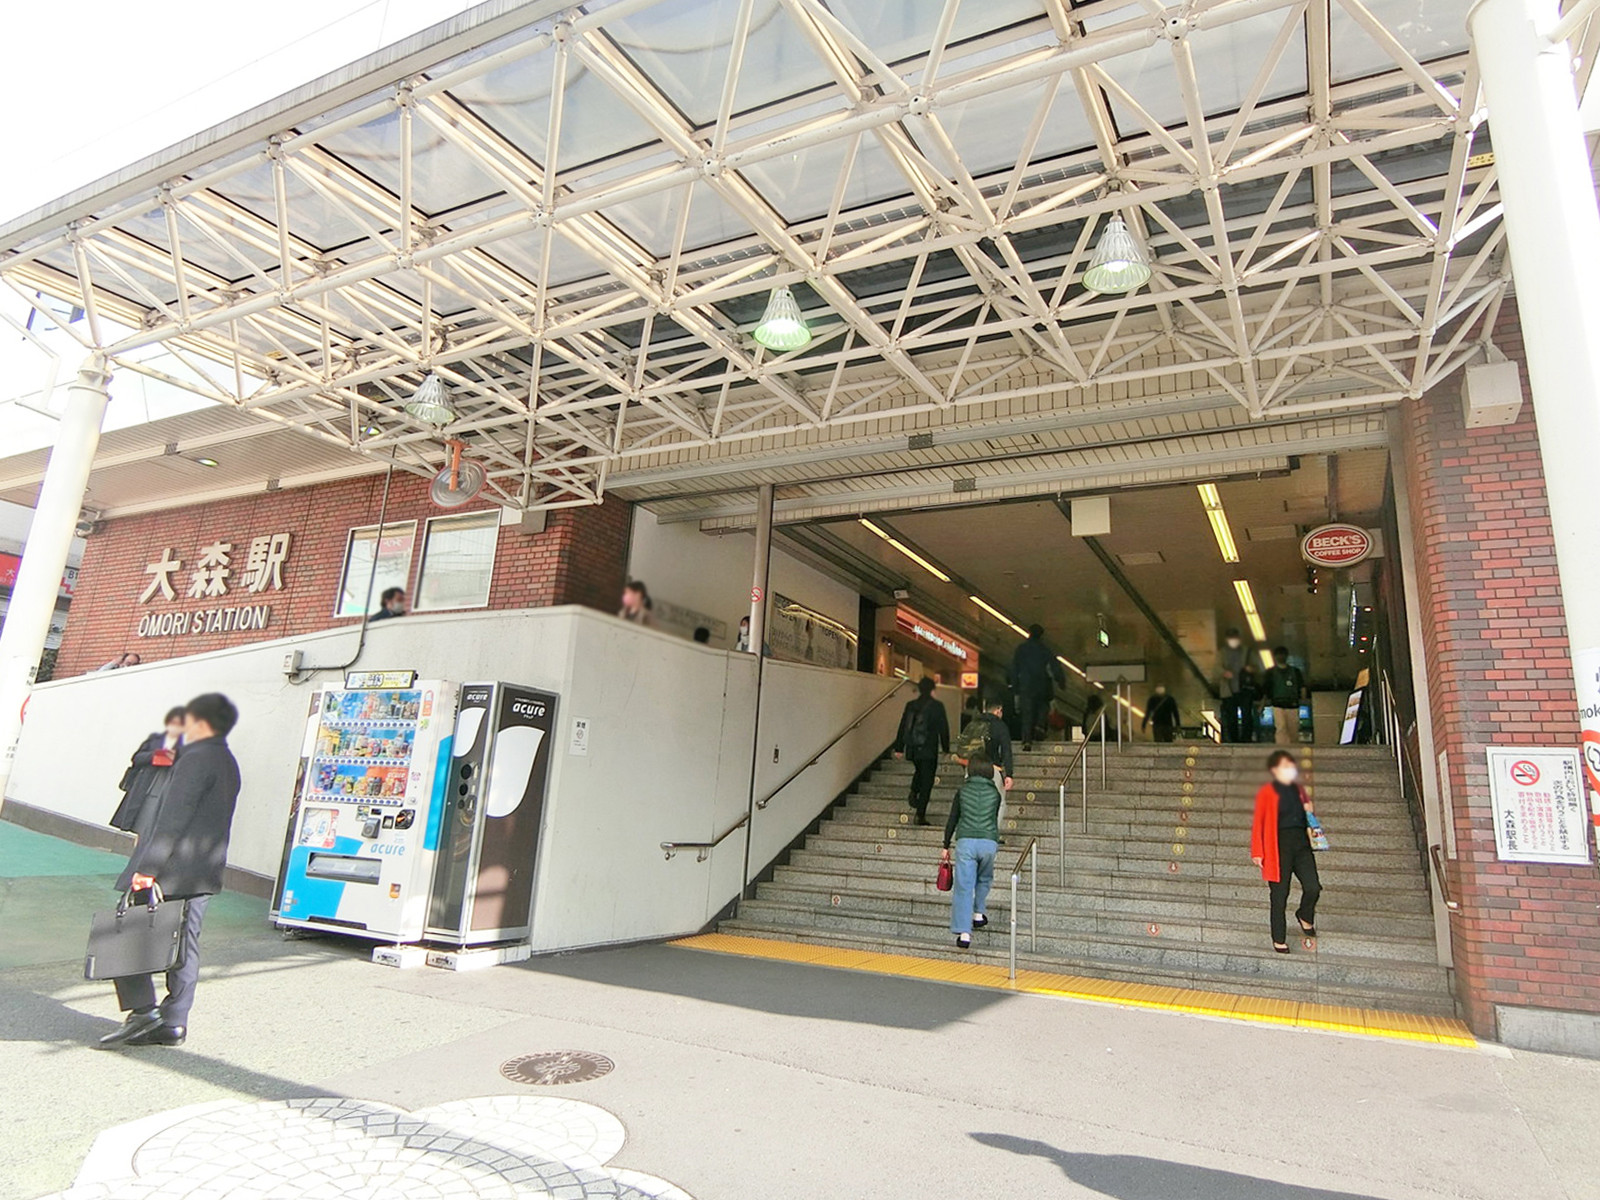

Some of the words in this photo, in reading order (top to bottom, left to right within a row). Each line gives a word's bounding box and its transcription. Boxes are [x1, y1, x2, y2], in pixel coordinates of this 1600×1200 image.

[1312, 535, 1361, 547] BECK'S
[1314, 549, 1341, 557] COFFEE
[139, 533, 291, 604] 大森駅
[192, 605, 269, 633] STATION
[512, 702, 546, 717] acure
[1504, 809, 1518, 851] 大森駅長
[370, 842, 405, 856] acure
